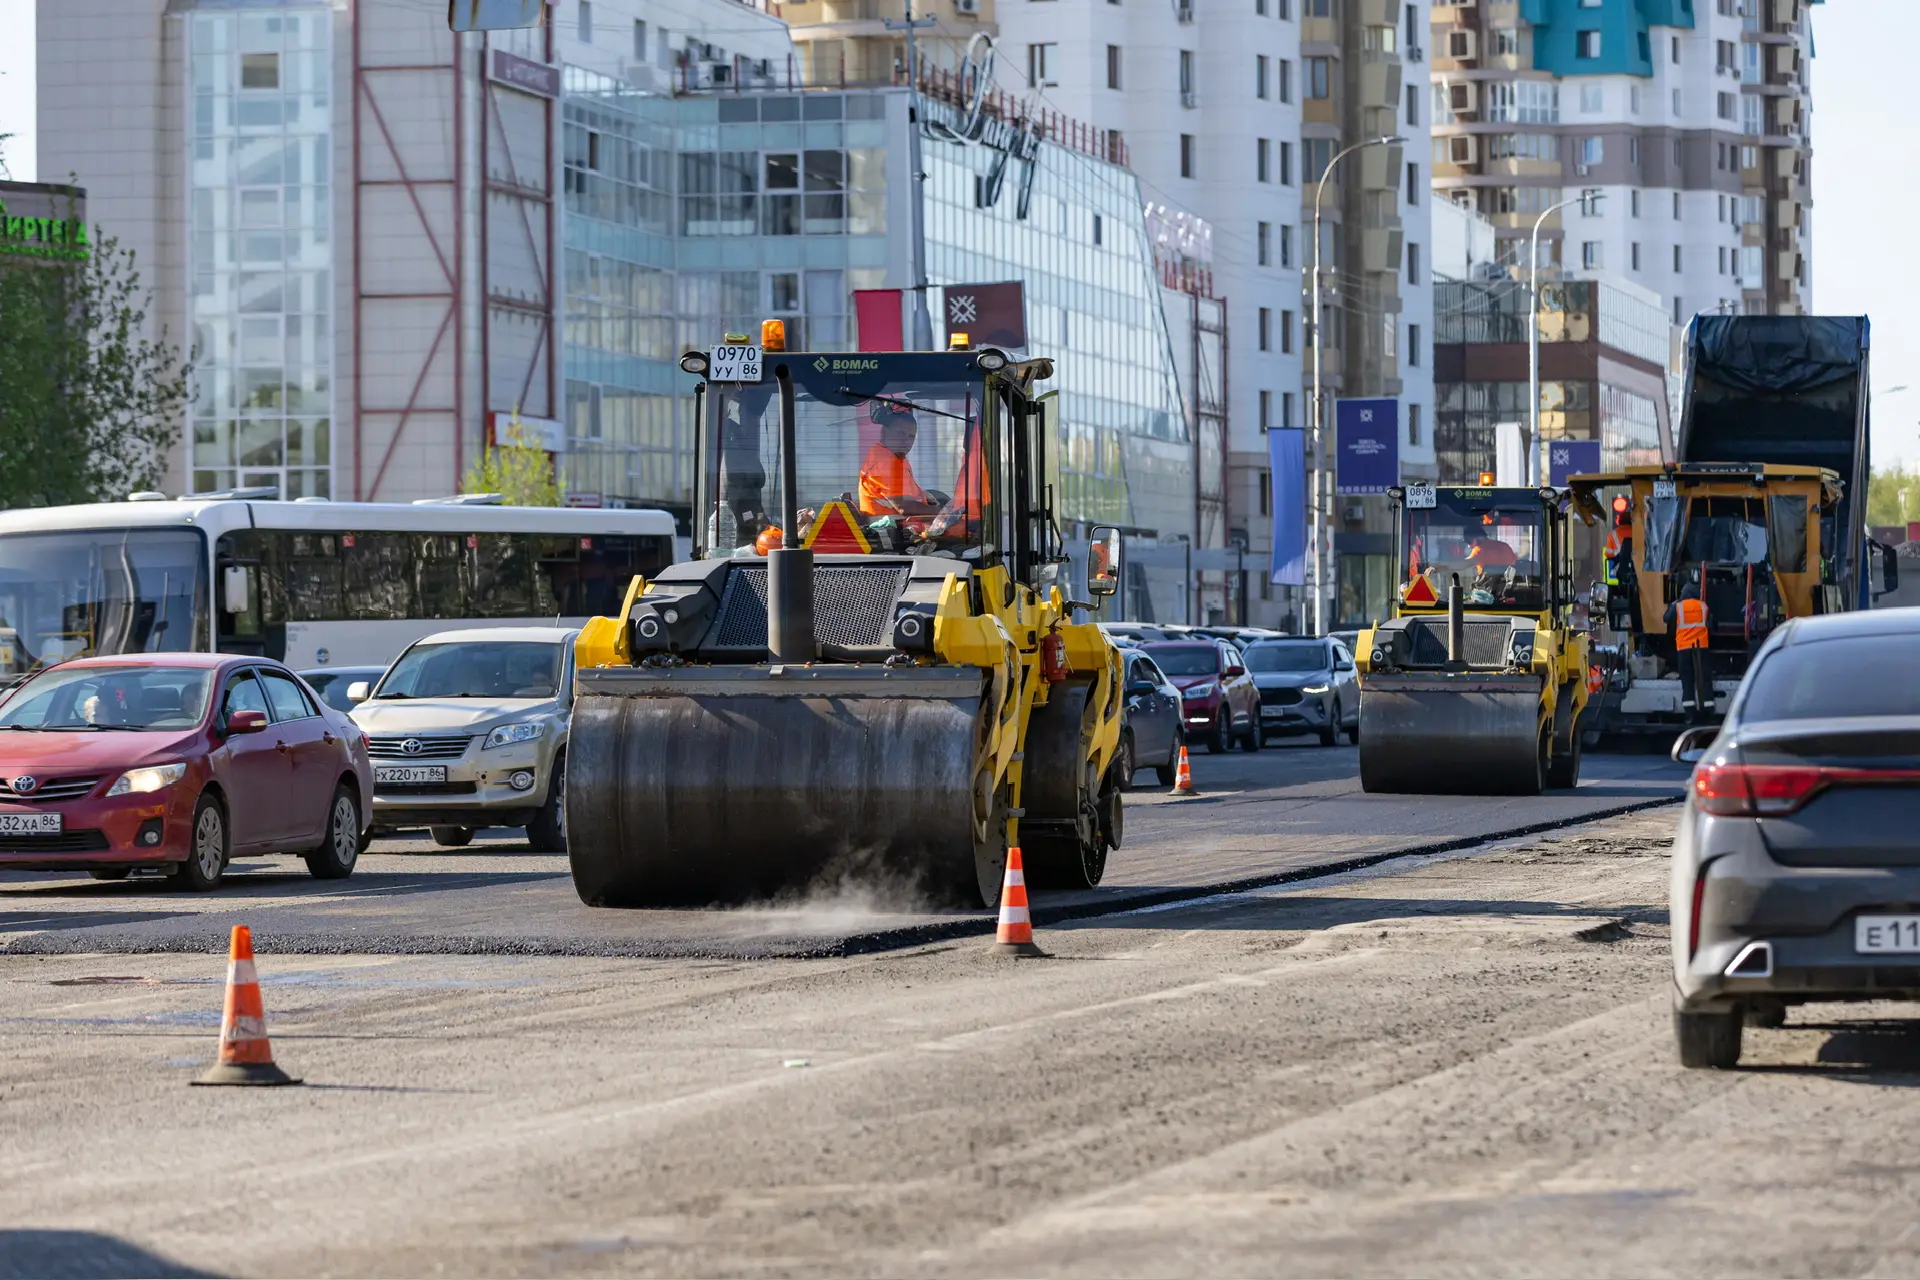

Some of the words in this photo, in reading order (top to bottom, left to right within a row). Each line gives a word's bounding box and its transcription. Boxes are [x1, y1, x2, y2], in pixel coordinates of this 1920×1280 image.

[717, 347, 756, 361] 0970
[742, 364, 758, 375] 86
[832, 359, 879, 370] BOMAG
[1410, 487, 1433, 496] 0896
[429, 768, 441, 777] 86
[0, 816, 39, 831] 32ХА
[42, 815, 56, 826] 86
